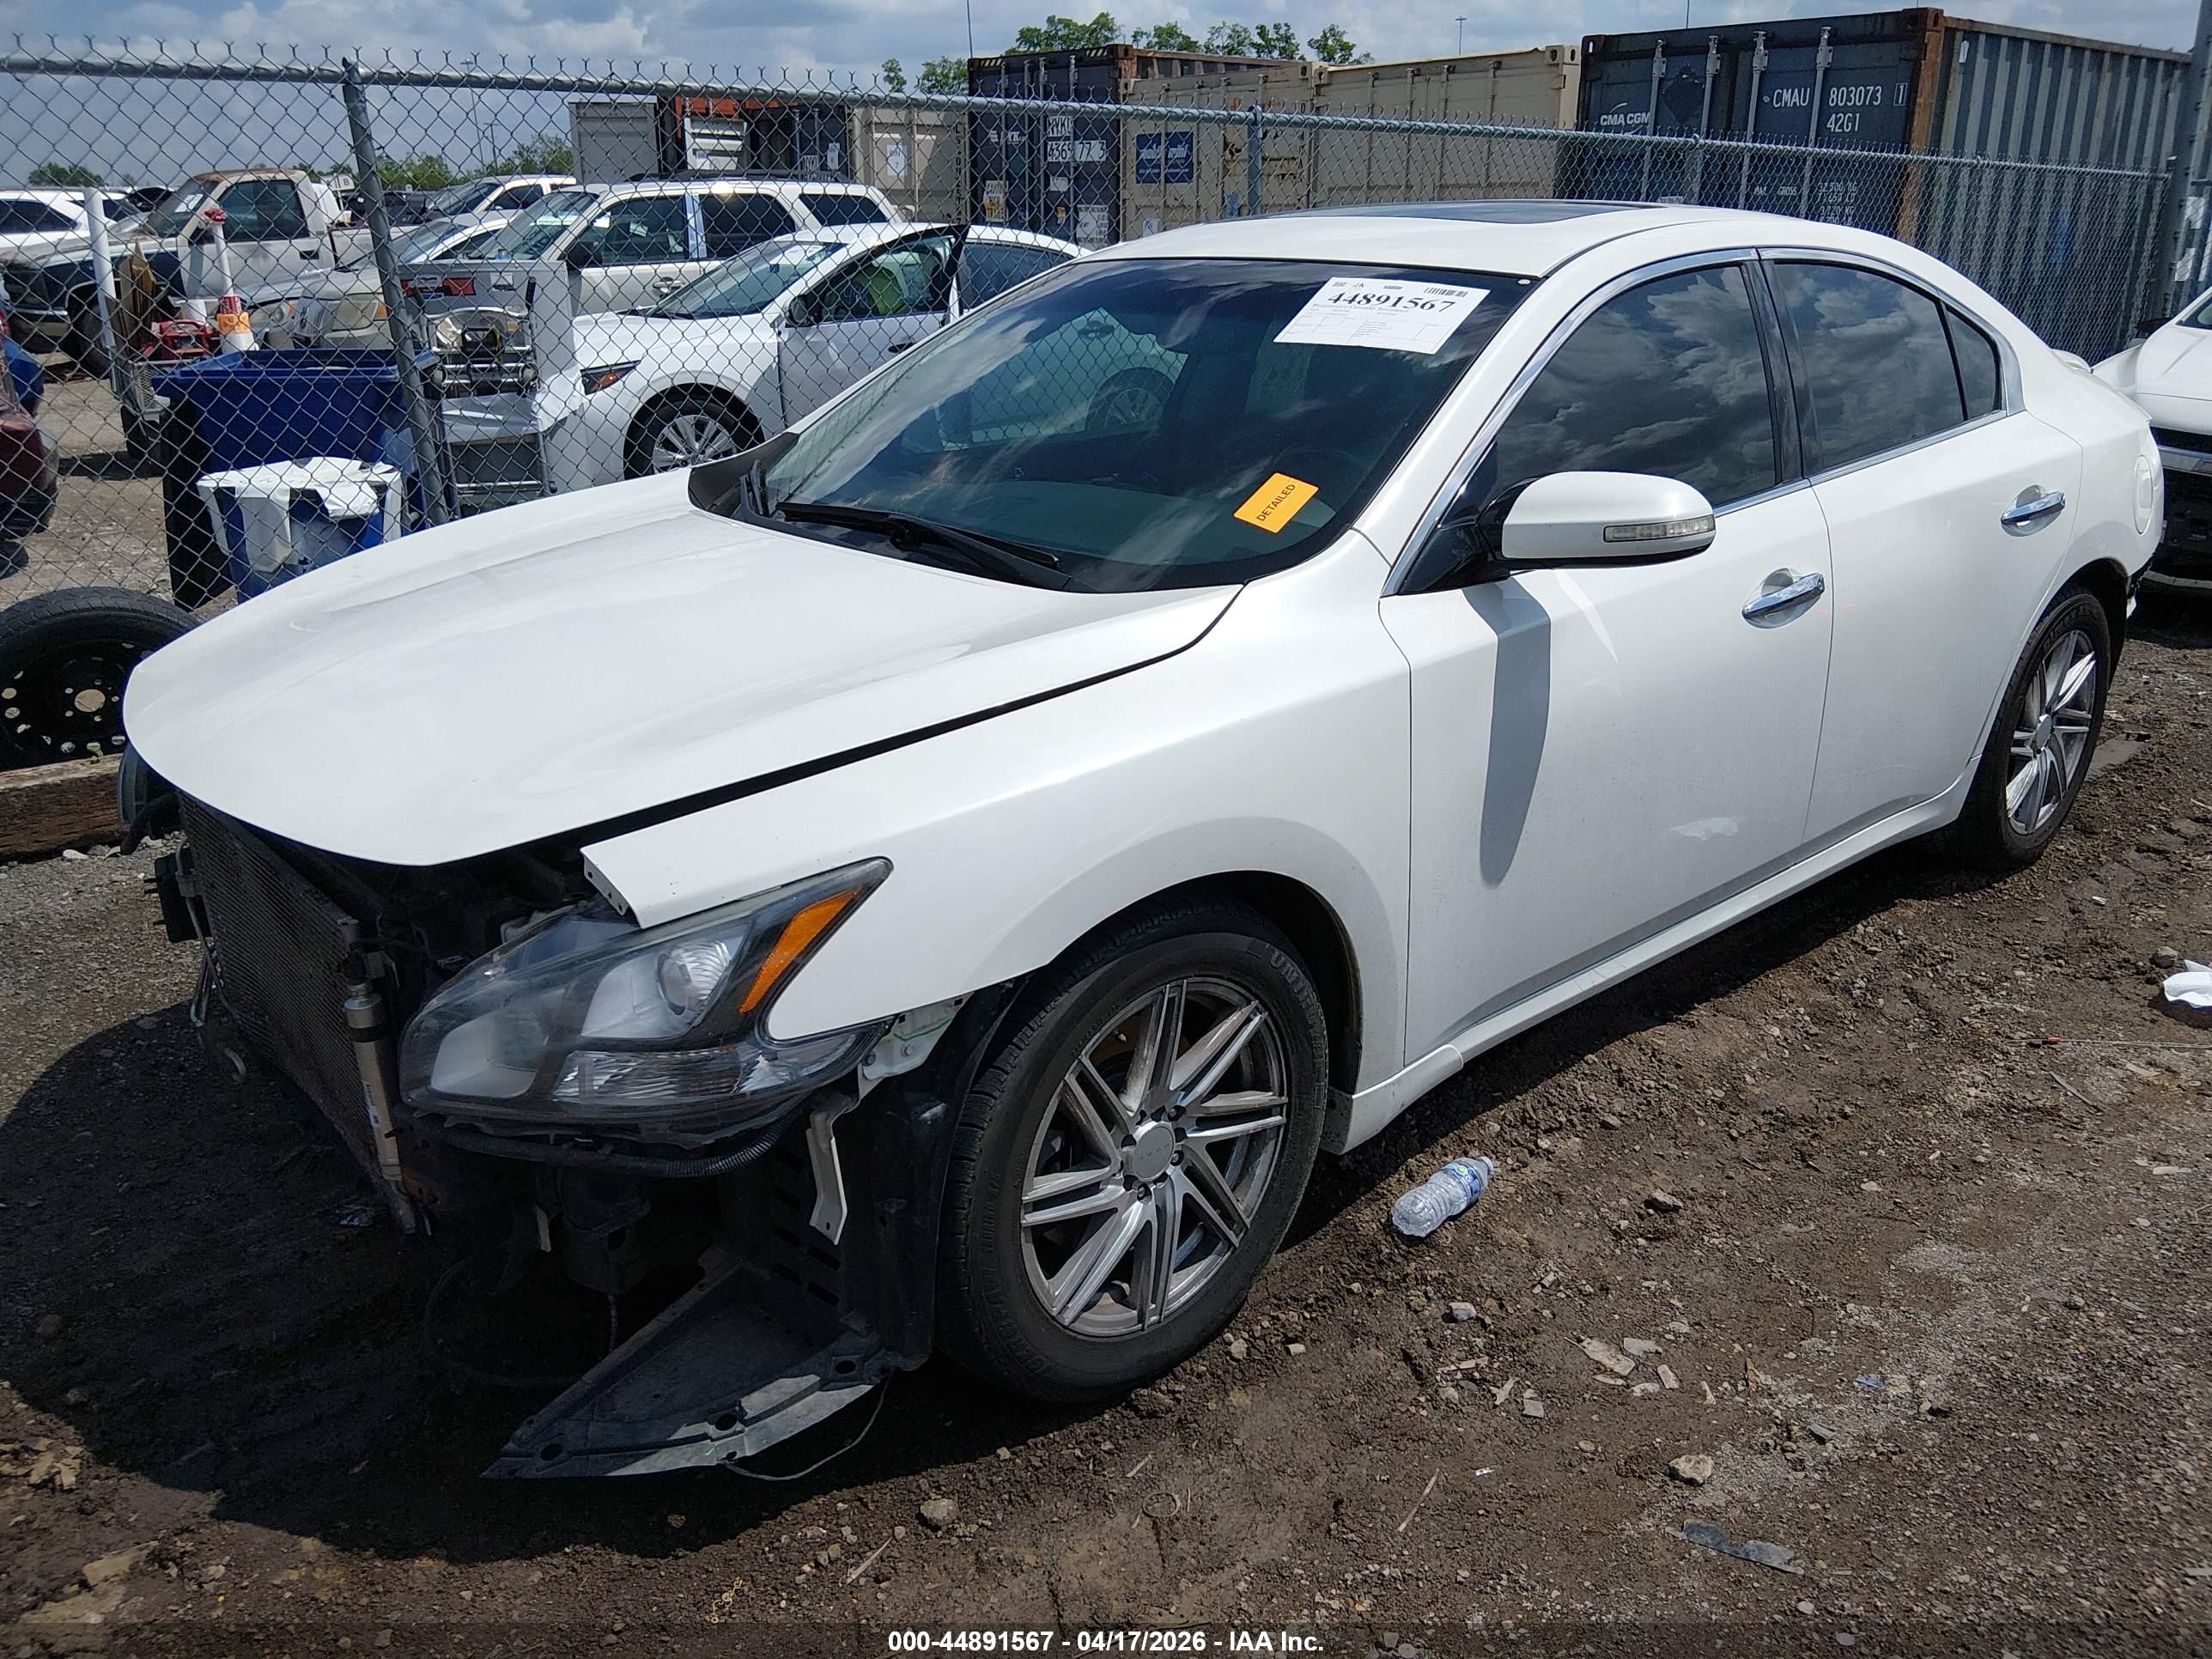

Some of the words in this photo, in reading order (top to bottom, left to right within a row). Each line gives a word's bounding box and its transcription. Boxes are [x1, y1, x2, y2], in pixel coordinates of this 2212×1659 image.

[1772, 88, 1810, 107] CMAU
[1828, 85, 1881, 106] 803073
[1600, 113, 1625, 125] CMA
[1826, 112, 1860, 132] 42G1
[1328, 291, 1455, 313] 44891567
[1256, 483, 1297, 521] DETAILED
